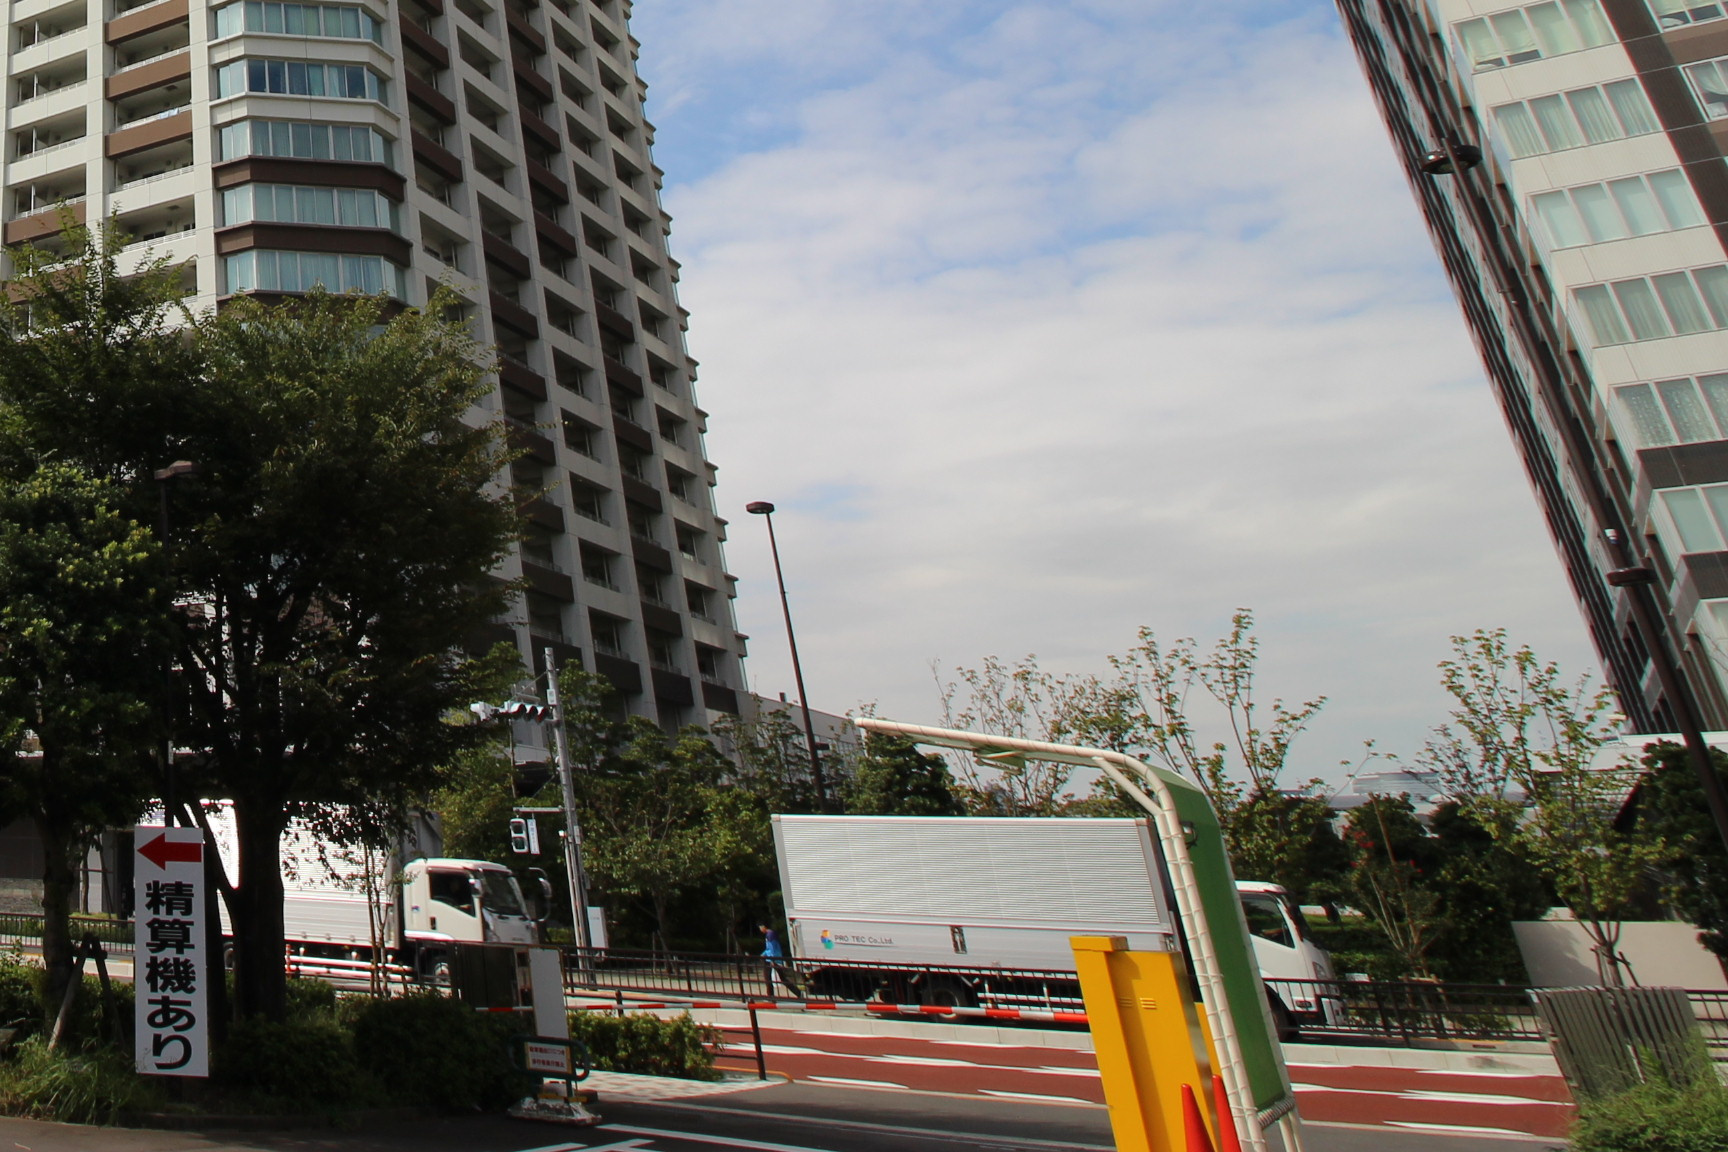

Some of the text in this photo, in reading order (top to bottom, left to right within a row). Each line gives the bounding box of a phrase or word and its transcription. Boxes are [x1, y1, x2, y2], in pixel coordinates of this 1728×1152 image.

[145, 880, 197, 1070] 精算機あり
[834, 934, 849, 942] PRO
[851, 935, 866, 943] TEC
